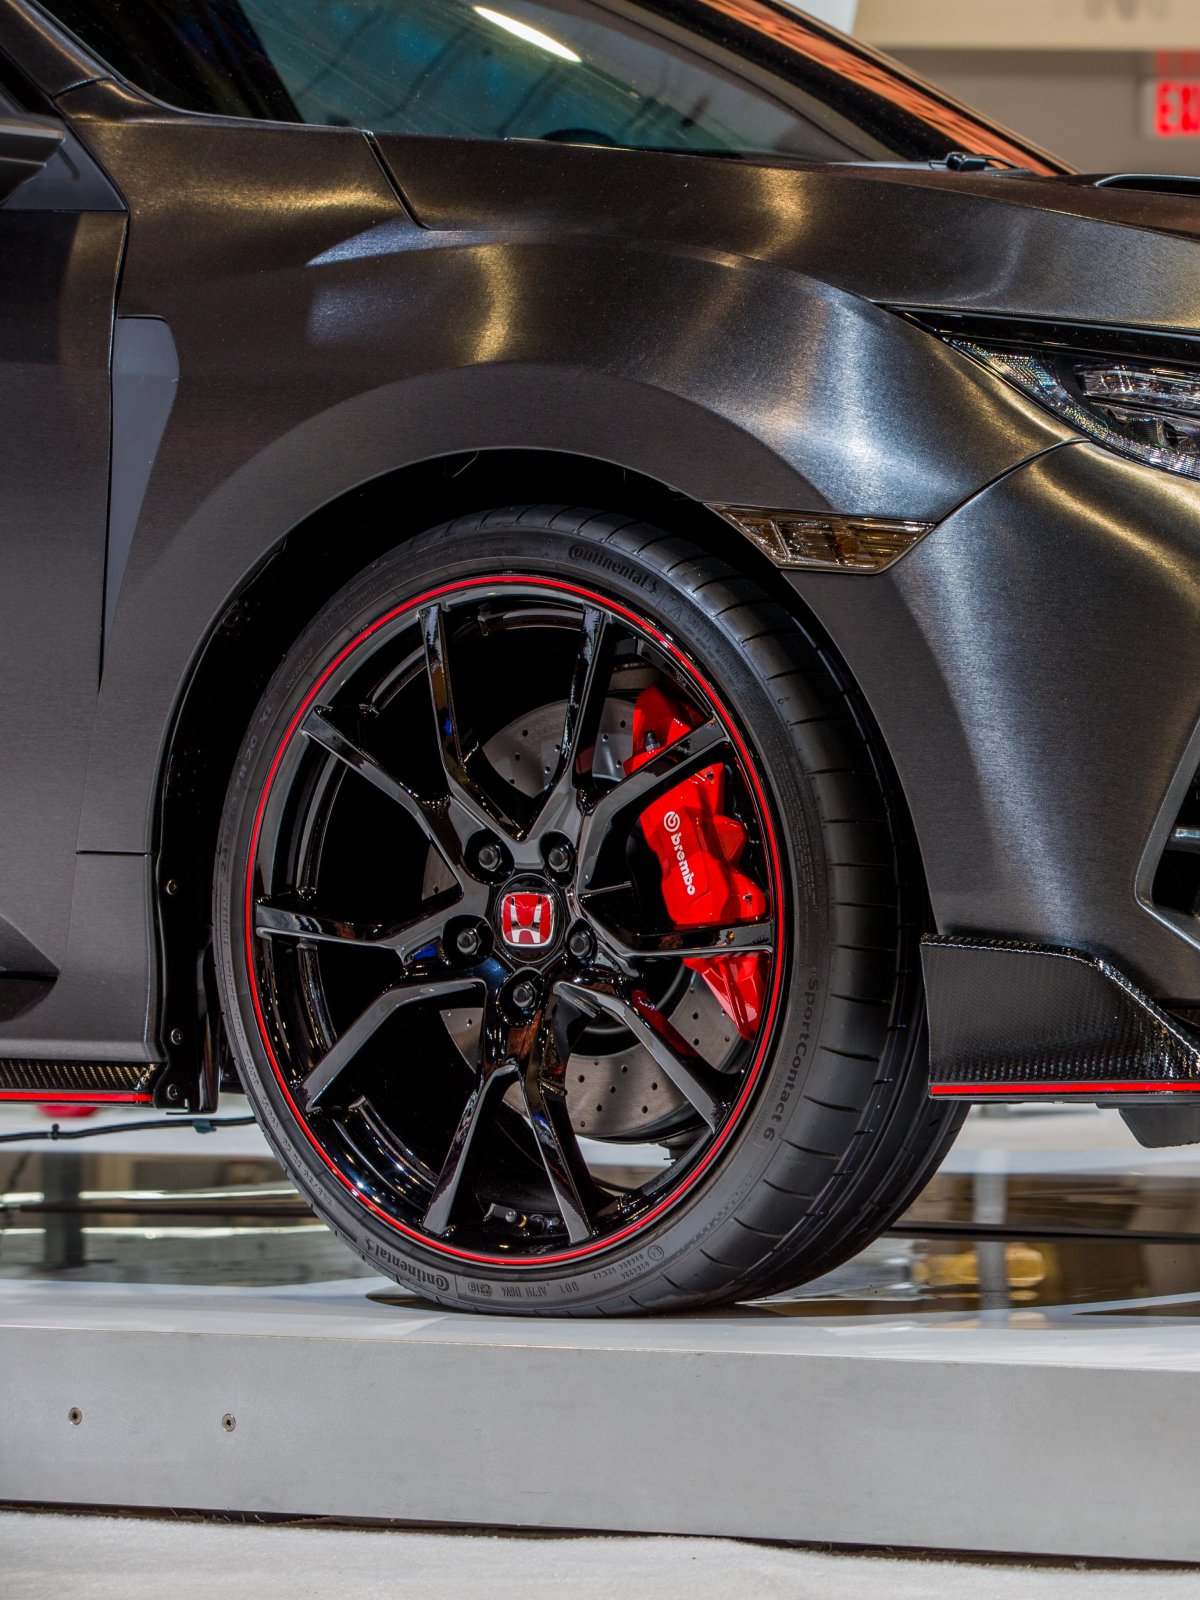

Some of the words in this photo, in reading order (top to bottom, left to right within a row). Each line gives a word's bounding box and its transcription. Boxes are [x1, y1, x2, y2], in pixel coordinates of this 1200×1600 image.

[568, 543, 650, 588] Continental
[670, 831, 696, 895] brembo
[771, 978, 819, 1124] SportContact
[762, 1128, 776, 1142] 6
[375, 1243, 450, 1292] Continental
